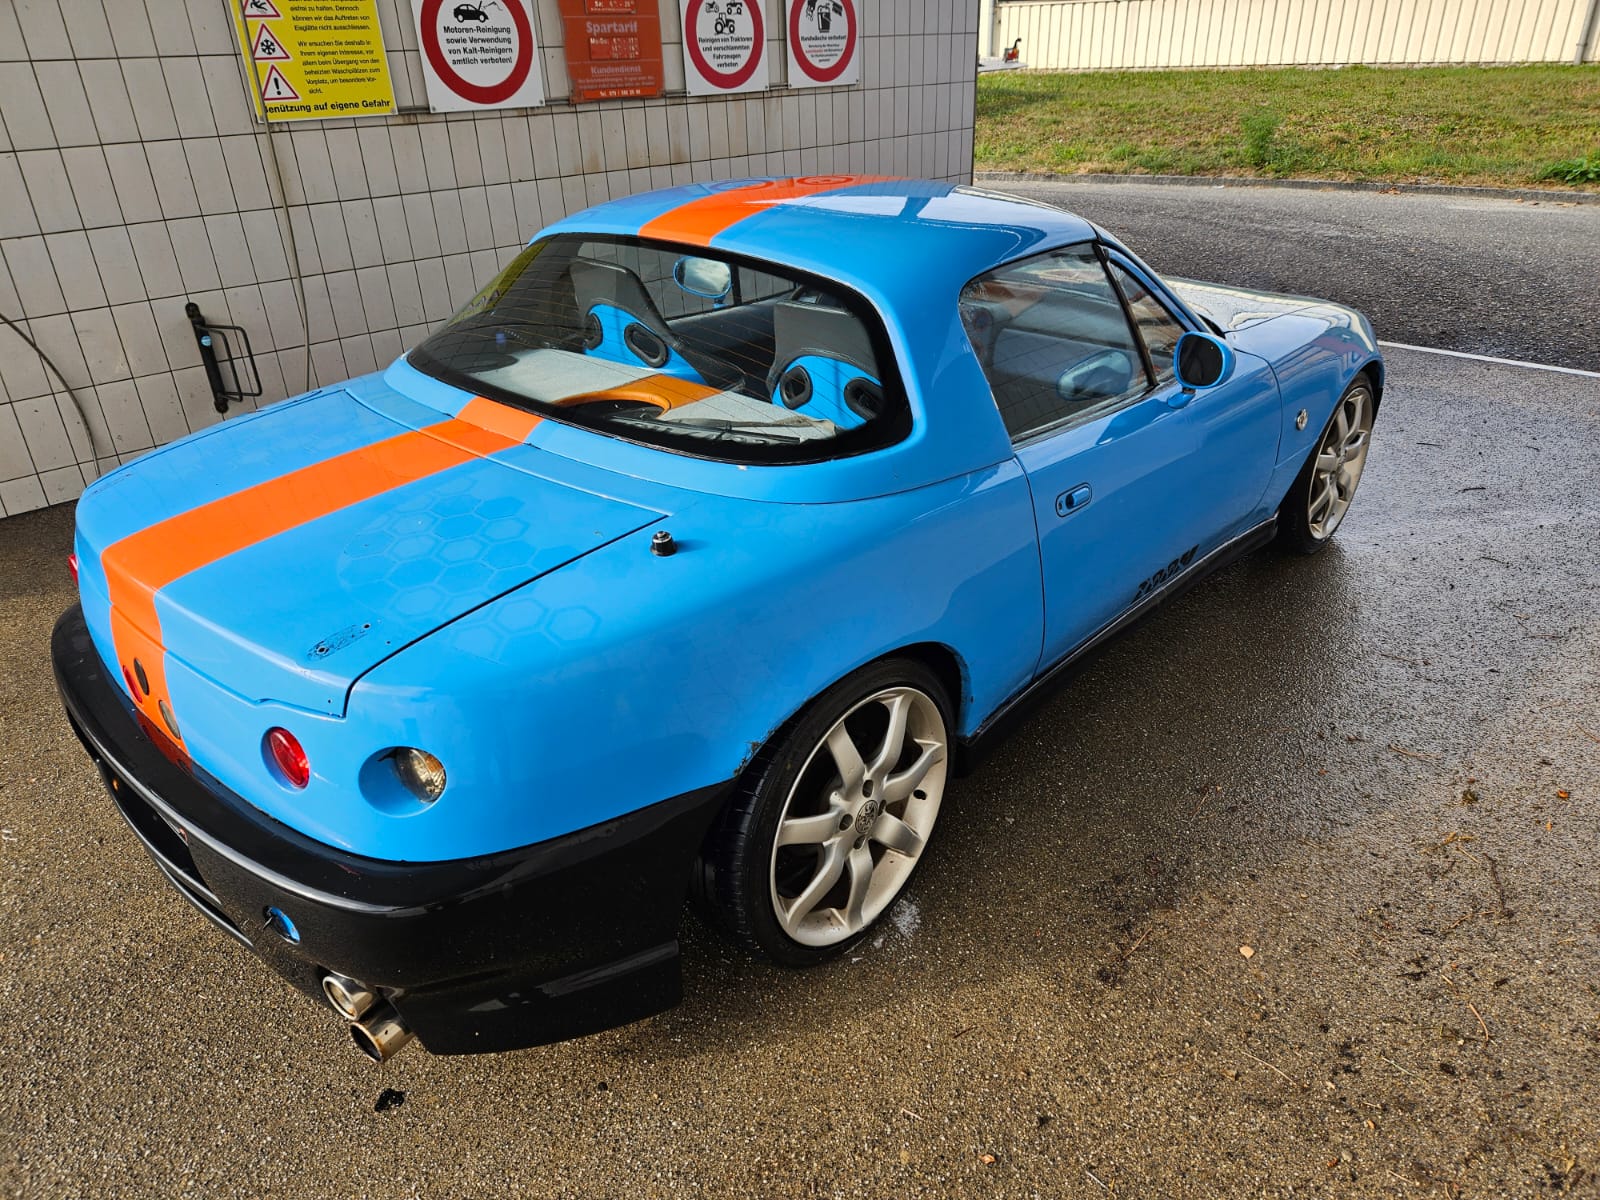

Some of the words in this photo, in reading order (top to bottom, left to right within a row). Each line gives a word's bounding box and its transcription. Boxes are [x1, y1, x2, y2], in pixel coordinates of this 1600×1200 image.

[443, 25, 511, 34] Motoren-Reinigung
[586, 21, 638, 36] Spartarif
[468, 36, 511, 44] Verwendung
[463, 46, 513, 55] Kalt-Reinigern
[452, 57, 478, 65] amtlich
[314, 102, 328, 111] auf
[331, 101, 359, 110] eigene
[362, 98, 390, 108] Gefahr
